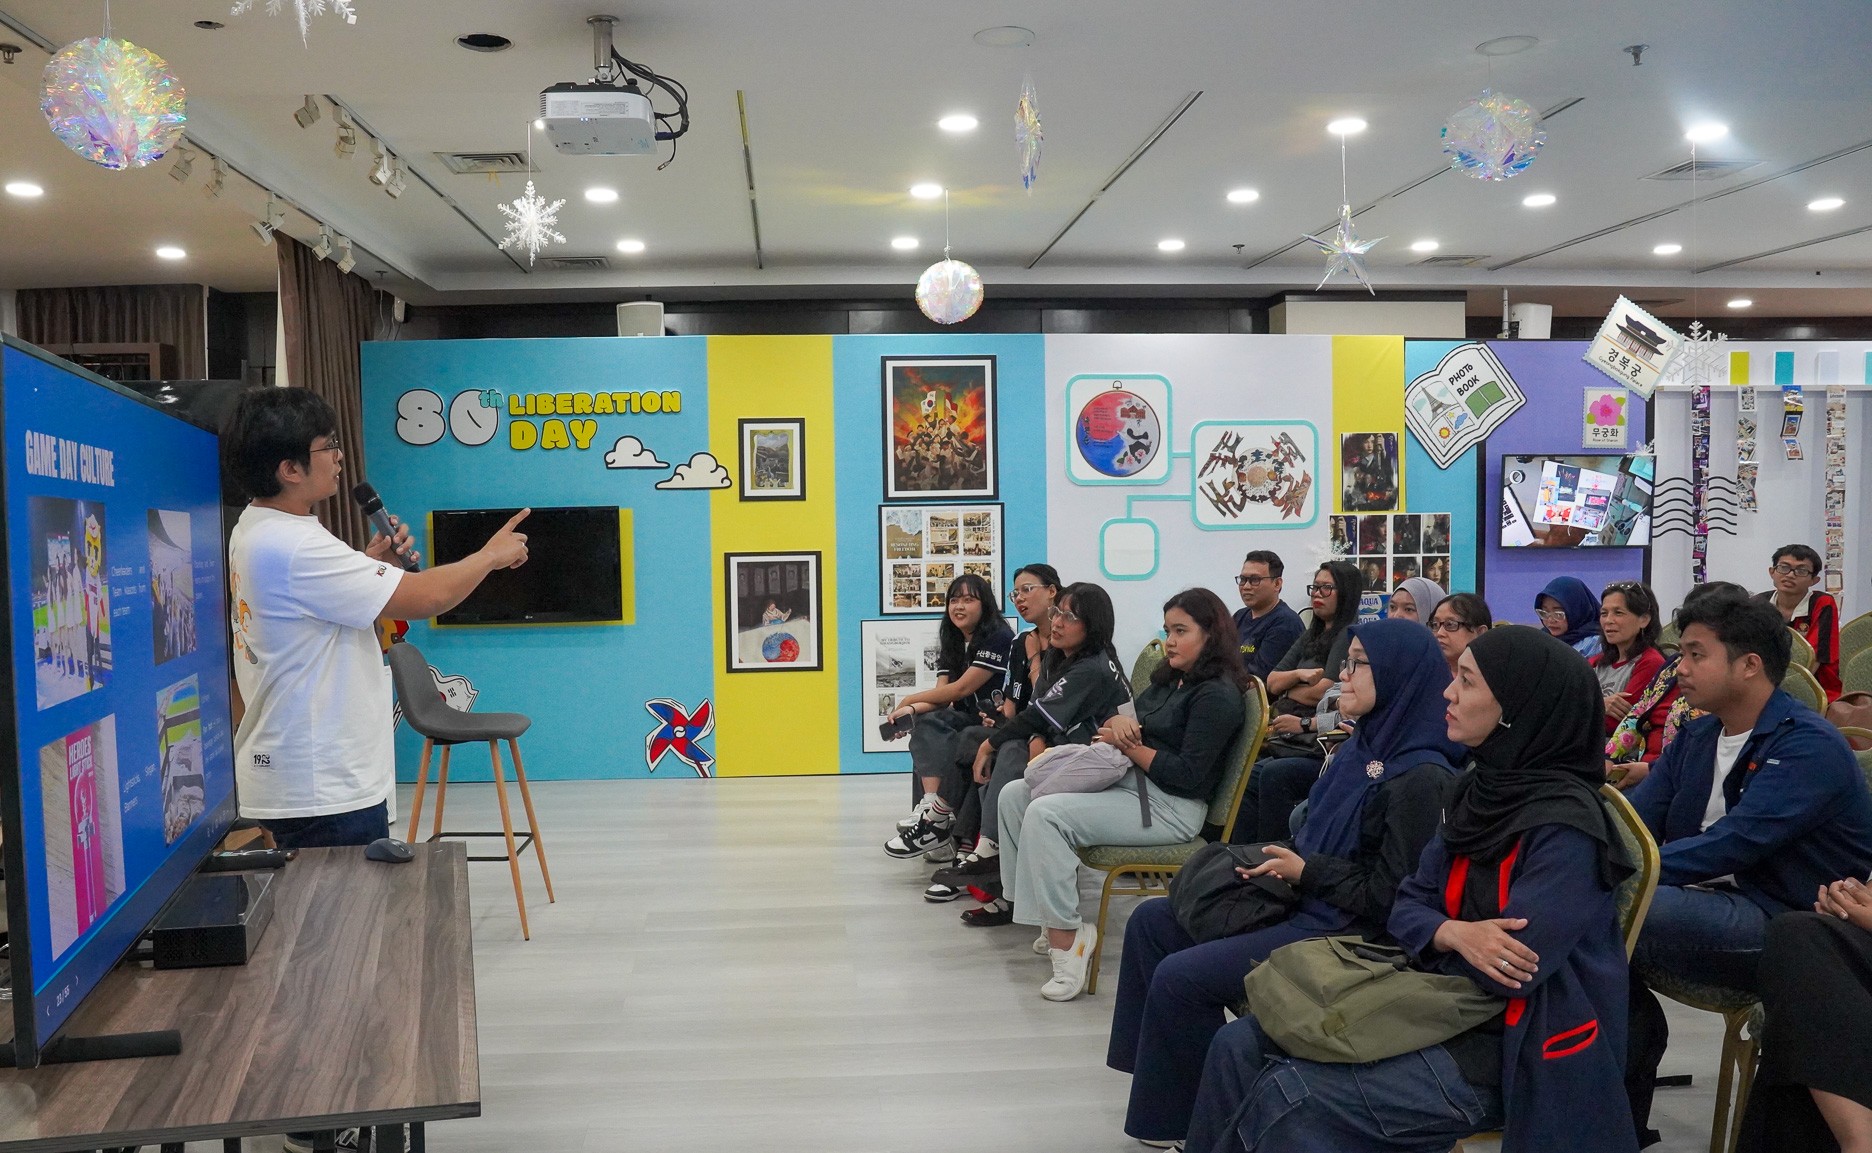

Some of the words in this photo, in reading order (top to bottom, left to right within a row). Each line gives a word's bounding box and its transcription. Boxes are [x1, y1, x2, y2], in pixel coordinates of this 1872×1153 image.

[1608, 348, 1643, 378] 경복궁
[1456, 375, 1481, 397] BOOK
[508, 391, 682, 416] LIBERATION
[509, 418, 599, 451] DAY
[1592, 427, 1619, 438] 무궁화
[25, 429, 58, 478] GAME
[58, 437, 78, 481] DAY
[79, 442, 115, 488] CULTURE
[1359, 597, 1379, 607] AQUA
[68, 736, 92, 767] HEROES
